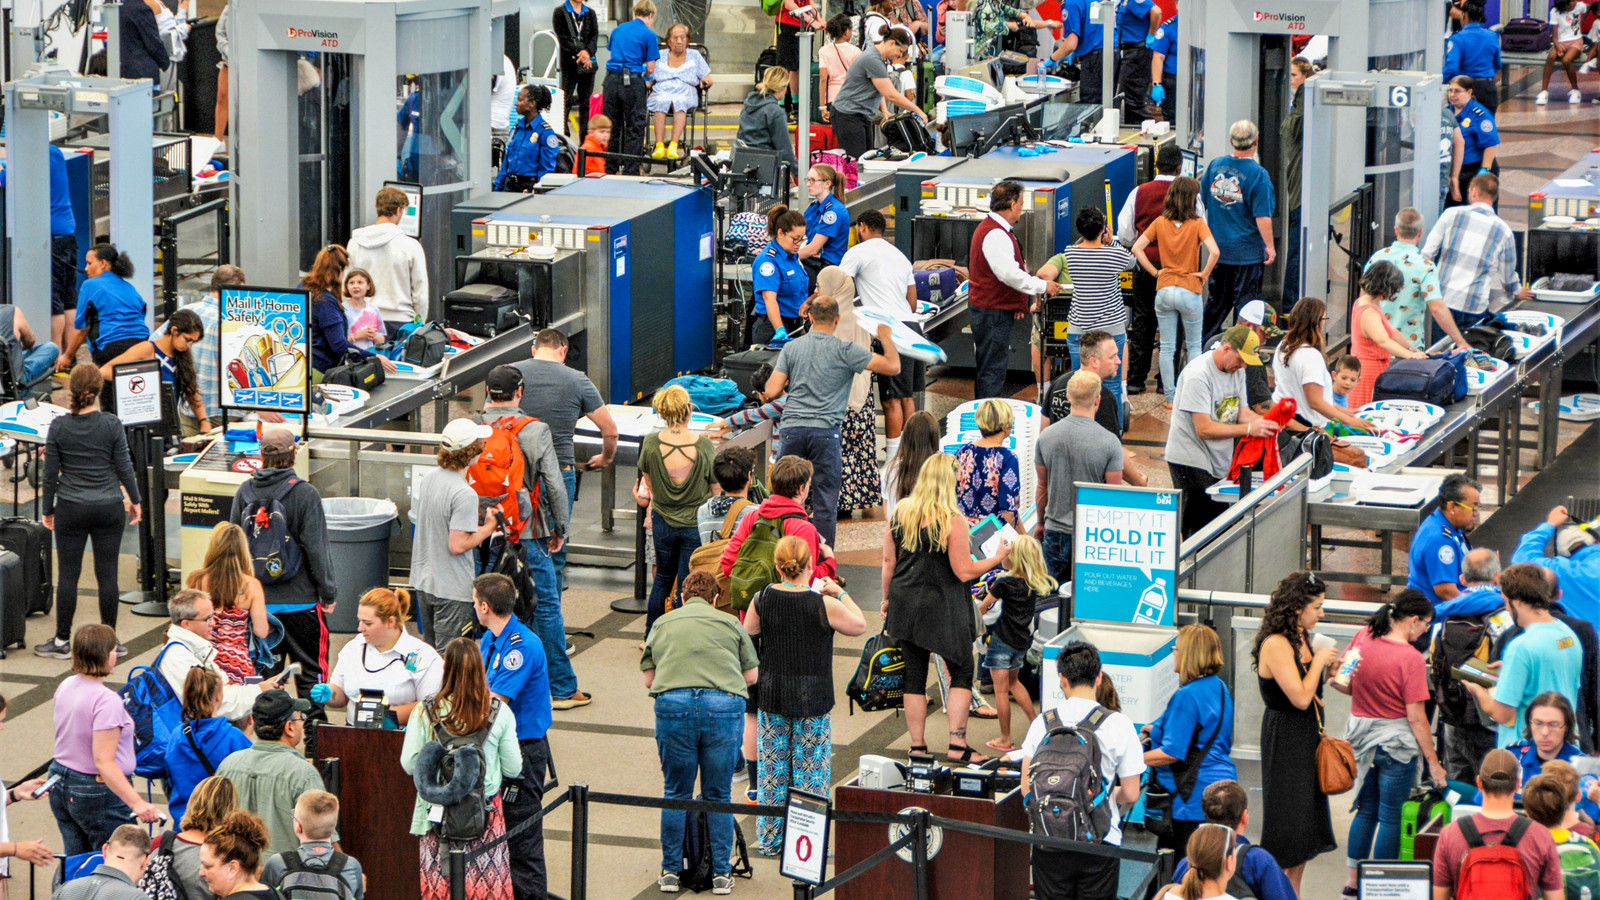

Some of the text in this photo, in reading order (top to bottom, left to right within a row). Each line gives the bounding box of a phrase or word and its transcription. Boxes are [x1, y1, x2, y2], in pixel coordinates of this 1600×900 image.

[1264, 12, 1306, 22] ProVision
[1287, 21, 1306, 31] ATD
[297, 28, 338, 39] ProVision
[321, 39, 339, 48] ATD
[1391, 86, 1408, 107] 6
[226, 296, 300, 312] Mail It Home
[227, 310, 265, 327] Safely!
[1085, 508, 1166, 528] EMPTY IT
[1085, 526, 1166, 547] HOLD IT
[1085, 545, 1166, 565] REFILL IT
[1084, 571, 1101, 579] POUR
[1116, 573, 1137, 581] WATER
[1097, 579, 1132, 588] BEVERAGES
[1111, 674, 1132, 683] ATER
